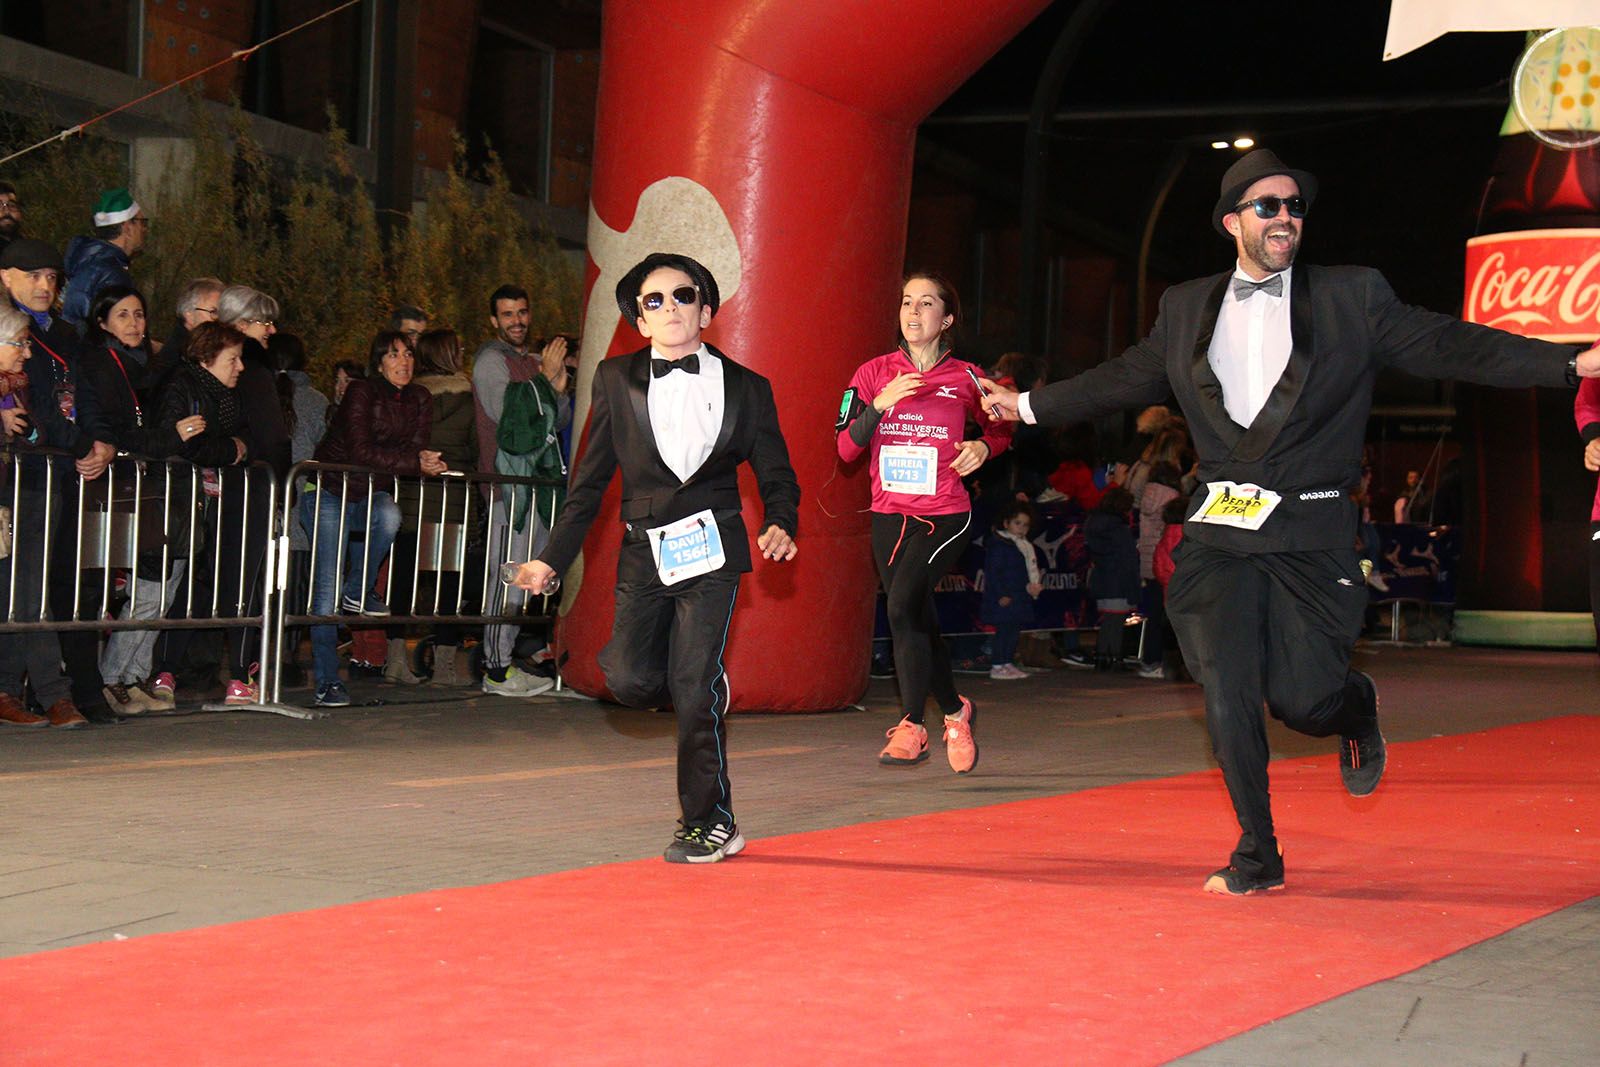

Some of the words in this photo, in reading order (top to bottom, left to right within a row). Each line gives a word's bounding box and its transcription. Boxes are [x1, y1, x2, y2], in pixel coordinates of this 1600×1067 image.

[898, 413, 924, 421] edició
[879, 423, 900, 431] SANT
[901, 424, 949, 434] SILVESTRE
[888, 459, 923, 469] MIREIA
[891, 470, 919, 480] 1713
[667, 531, 709, 551] DAVID
